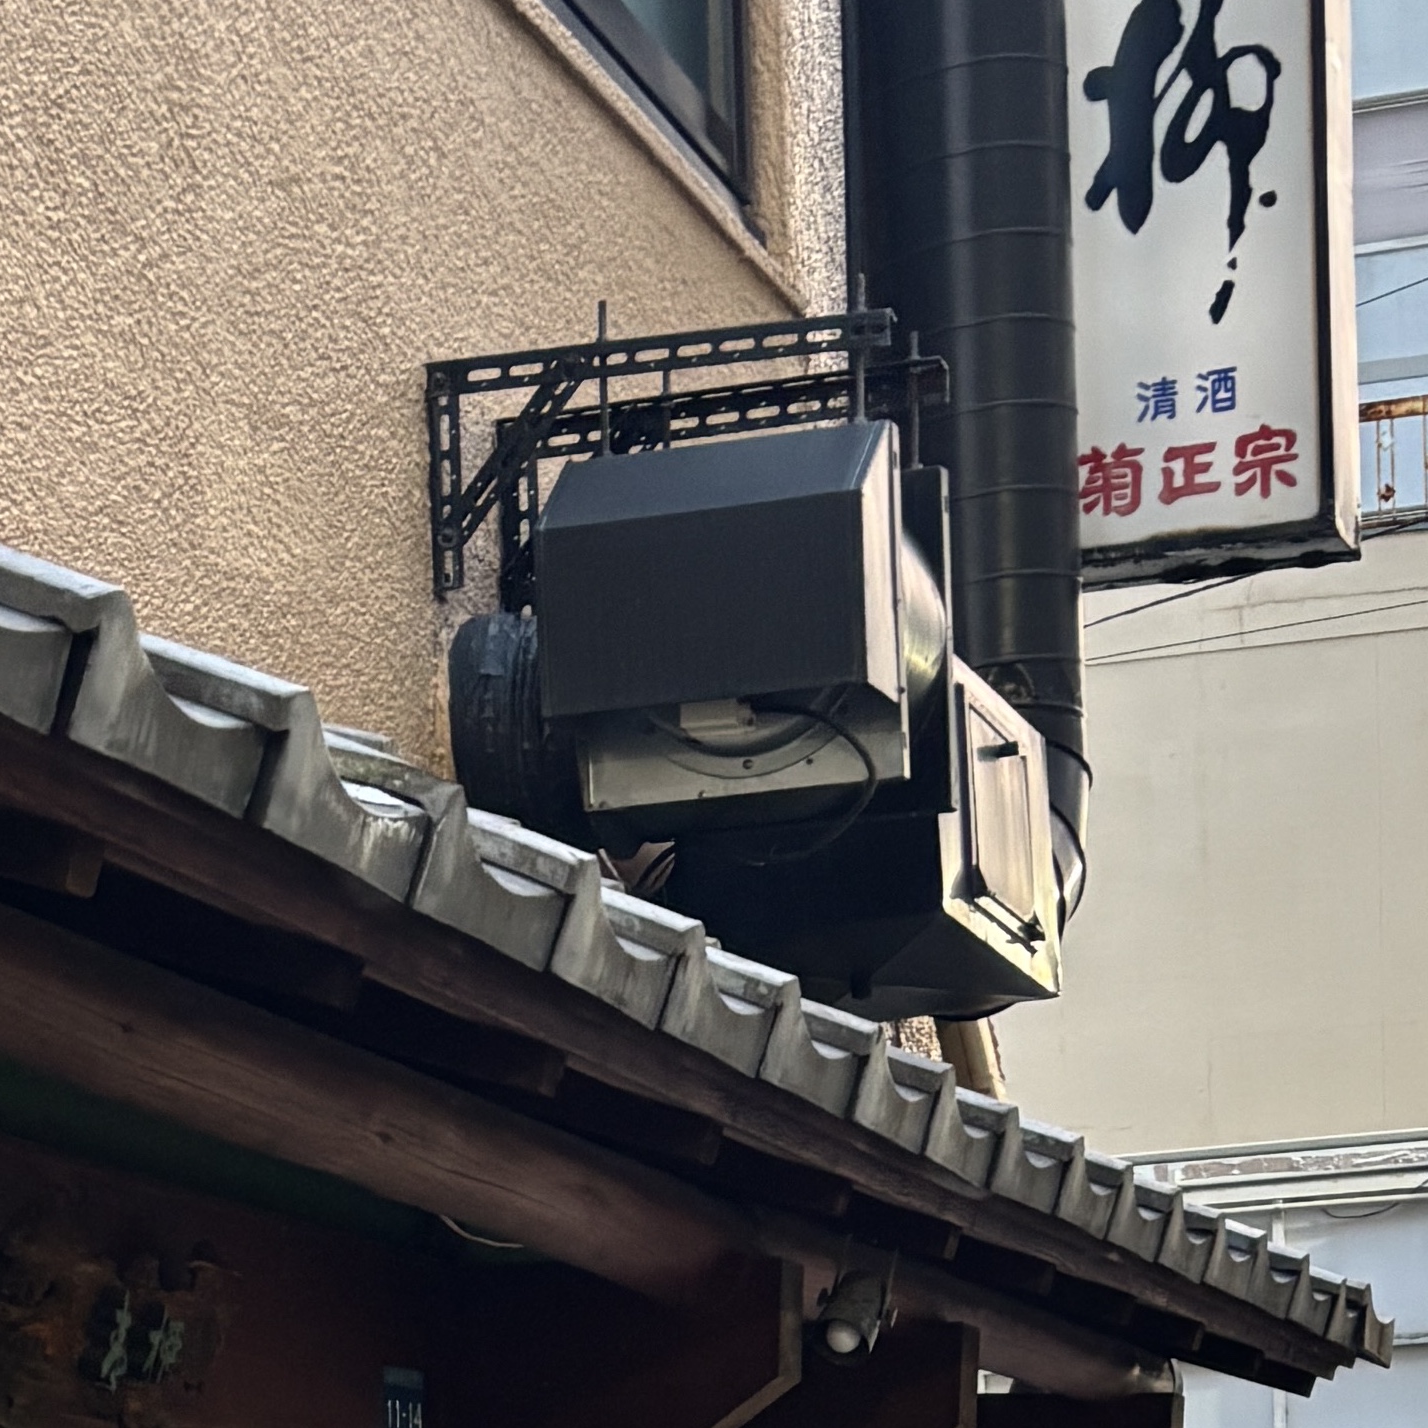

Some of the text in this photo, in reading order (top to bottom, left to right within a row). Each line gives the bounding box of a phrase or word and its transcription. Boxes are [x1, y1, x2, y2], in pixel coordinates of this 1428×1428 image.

[1136, 366, 1238, 423] 清酒
[1078, 424, 1299, 517] 菊正宗
